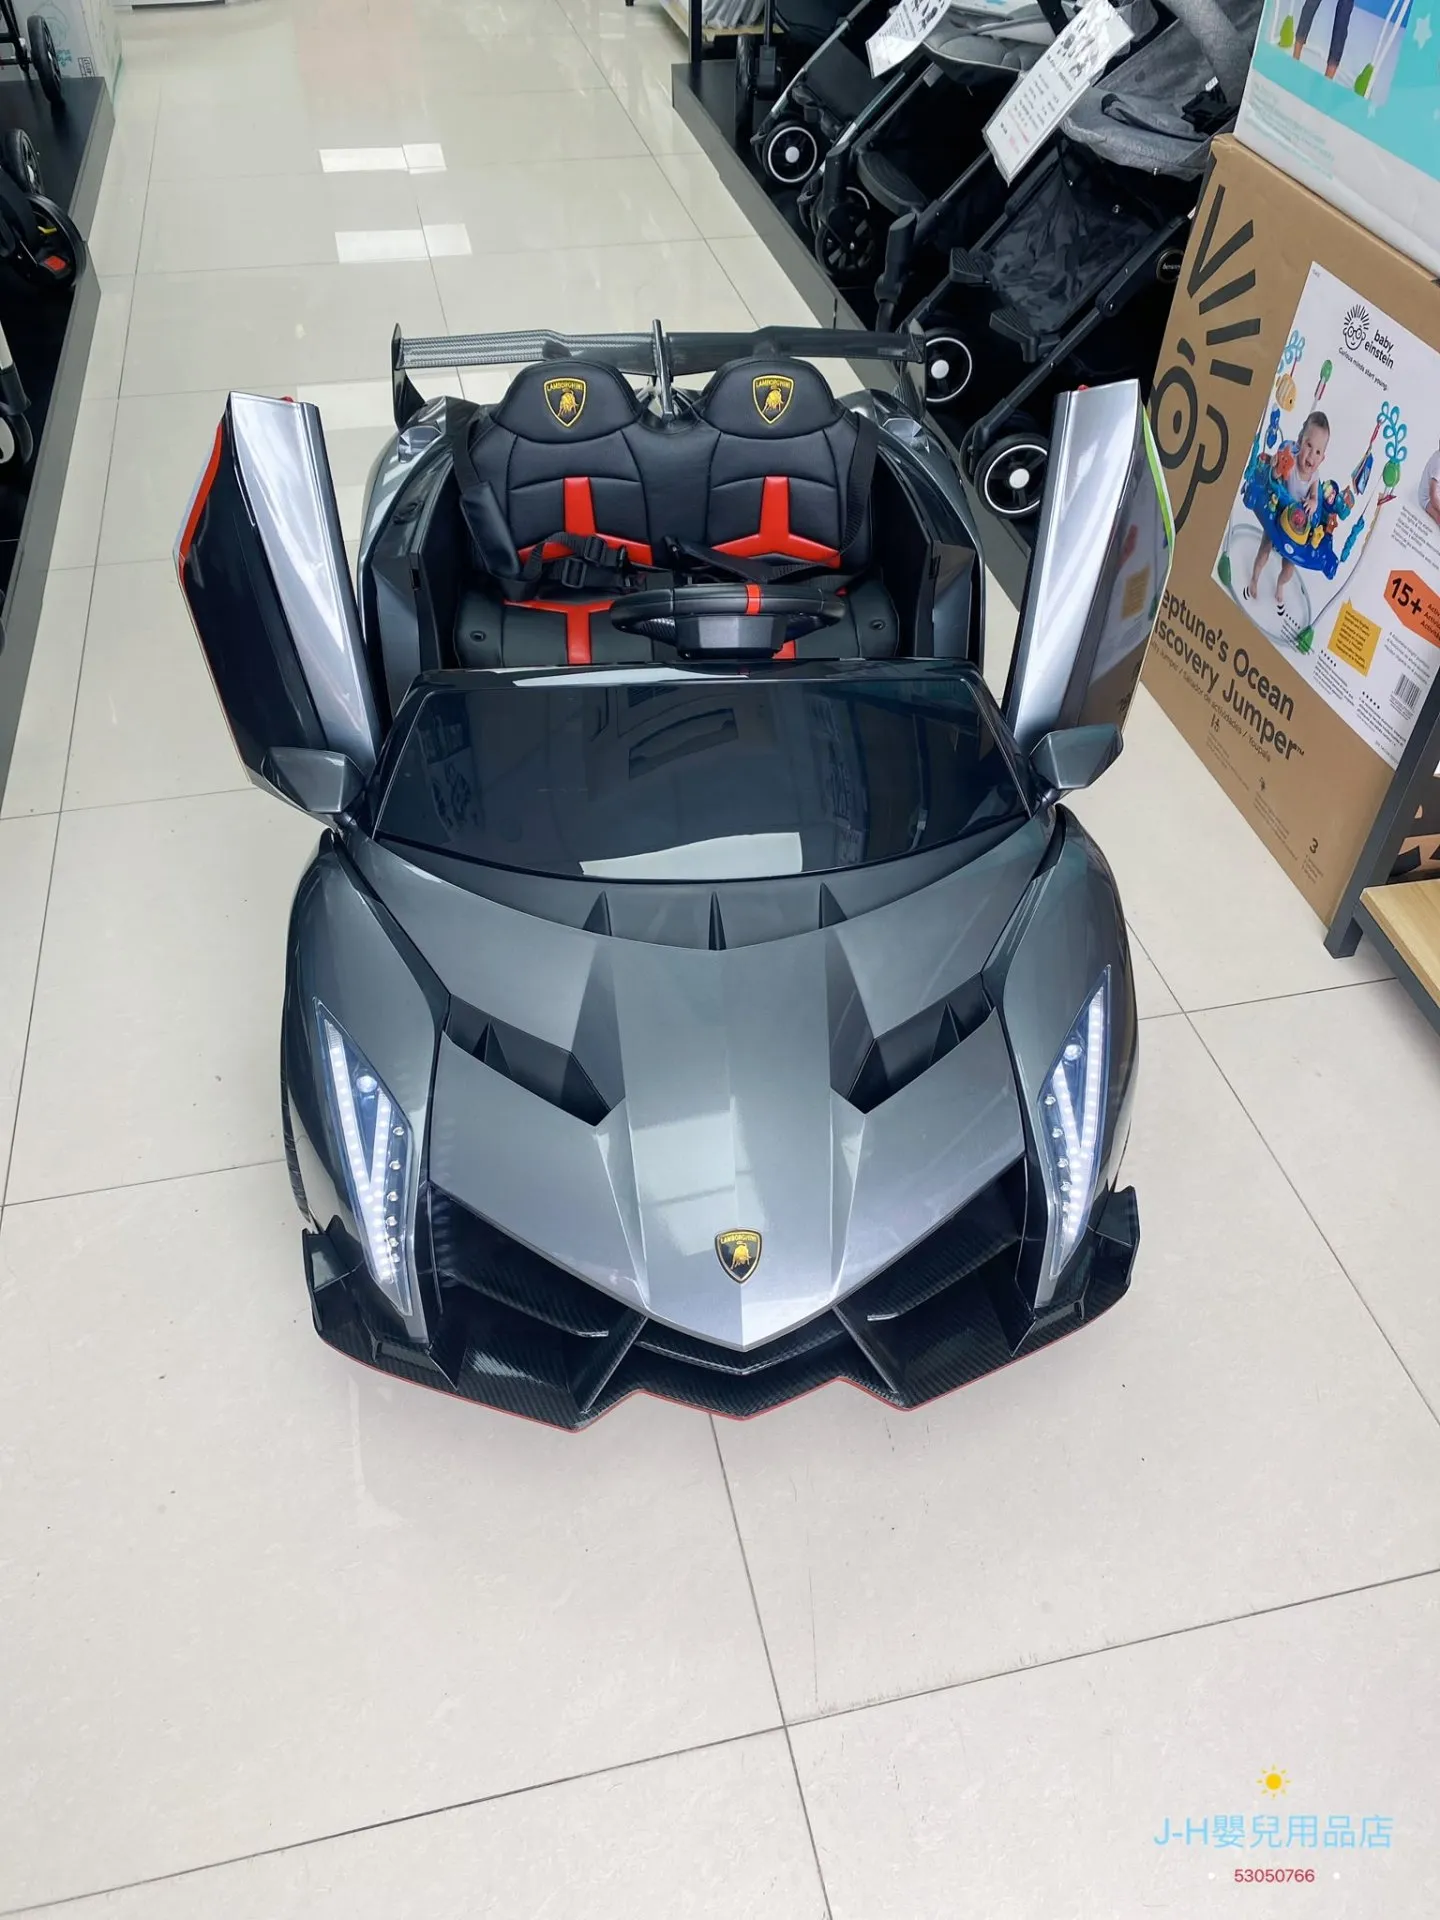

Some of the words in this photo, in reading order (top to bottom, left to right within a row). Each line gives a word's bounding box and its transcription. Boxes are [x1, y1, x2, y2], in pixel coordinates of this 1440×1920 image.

[1374, 329, 1394, 353] baby
[1364, 341, 1394, 369] einstein
[546, 381, 583, 391] LAMBORGHINI
[1391, 577, 1422, 615] 15+
[1154, 613, 1220, 694] iscovery
[1160, 588, 1229, 663] eptune's
[1233, 648, 1295, 721] Ocean
[1309, 837, 1318, 854] 3
[720, 1233, 757, 1244] LAMBORGHINI
